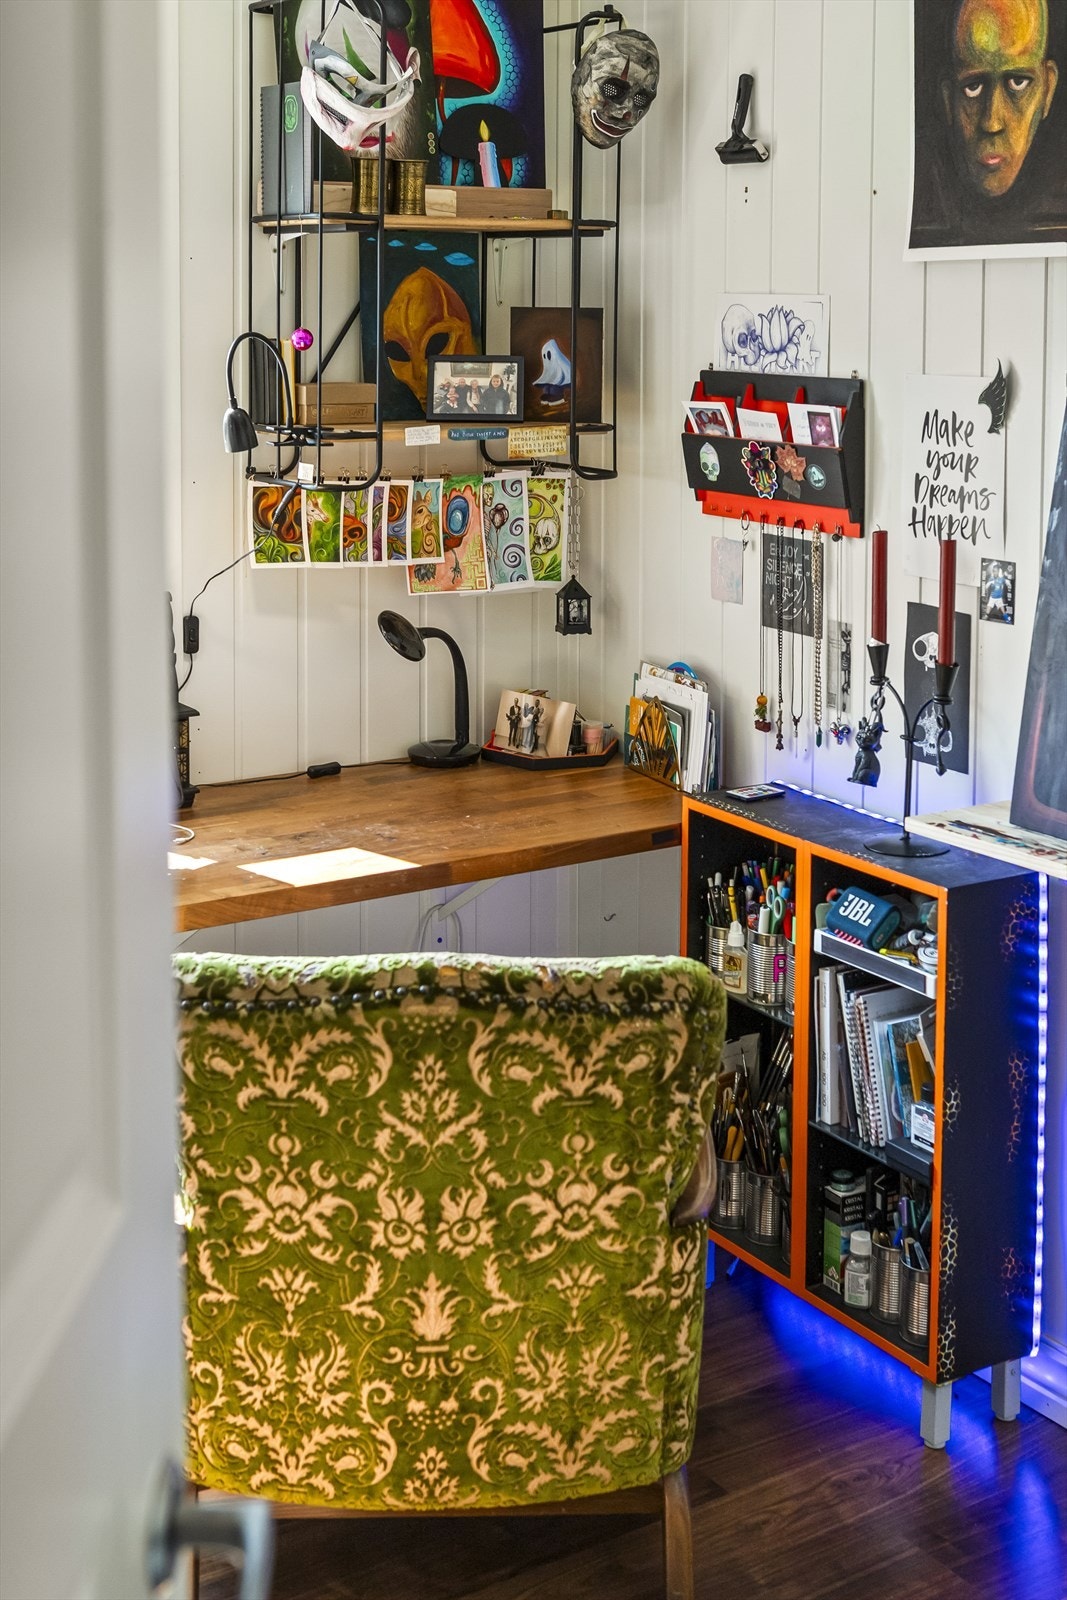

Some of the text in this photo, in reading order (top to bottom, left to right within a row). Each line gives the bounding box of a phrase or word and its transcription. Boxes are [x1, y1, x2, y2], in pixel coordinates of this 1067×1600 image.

[921, 408, 975, 448] Make
[926, 449, 979, 483] your
[914, 472, 997, 514] Dreams
[907, 504, 992, 547] Happen
[839, 893, 876, 927] JBL
